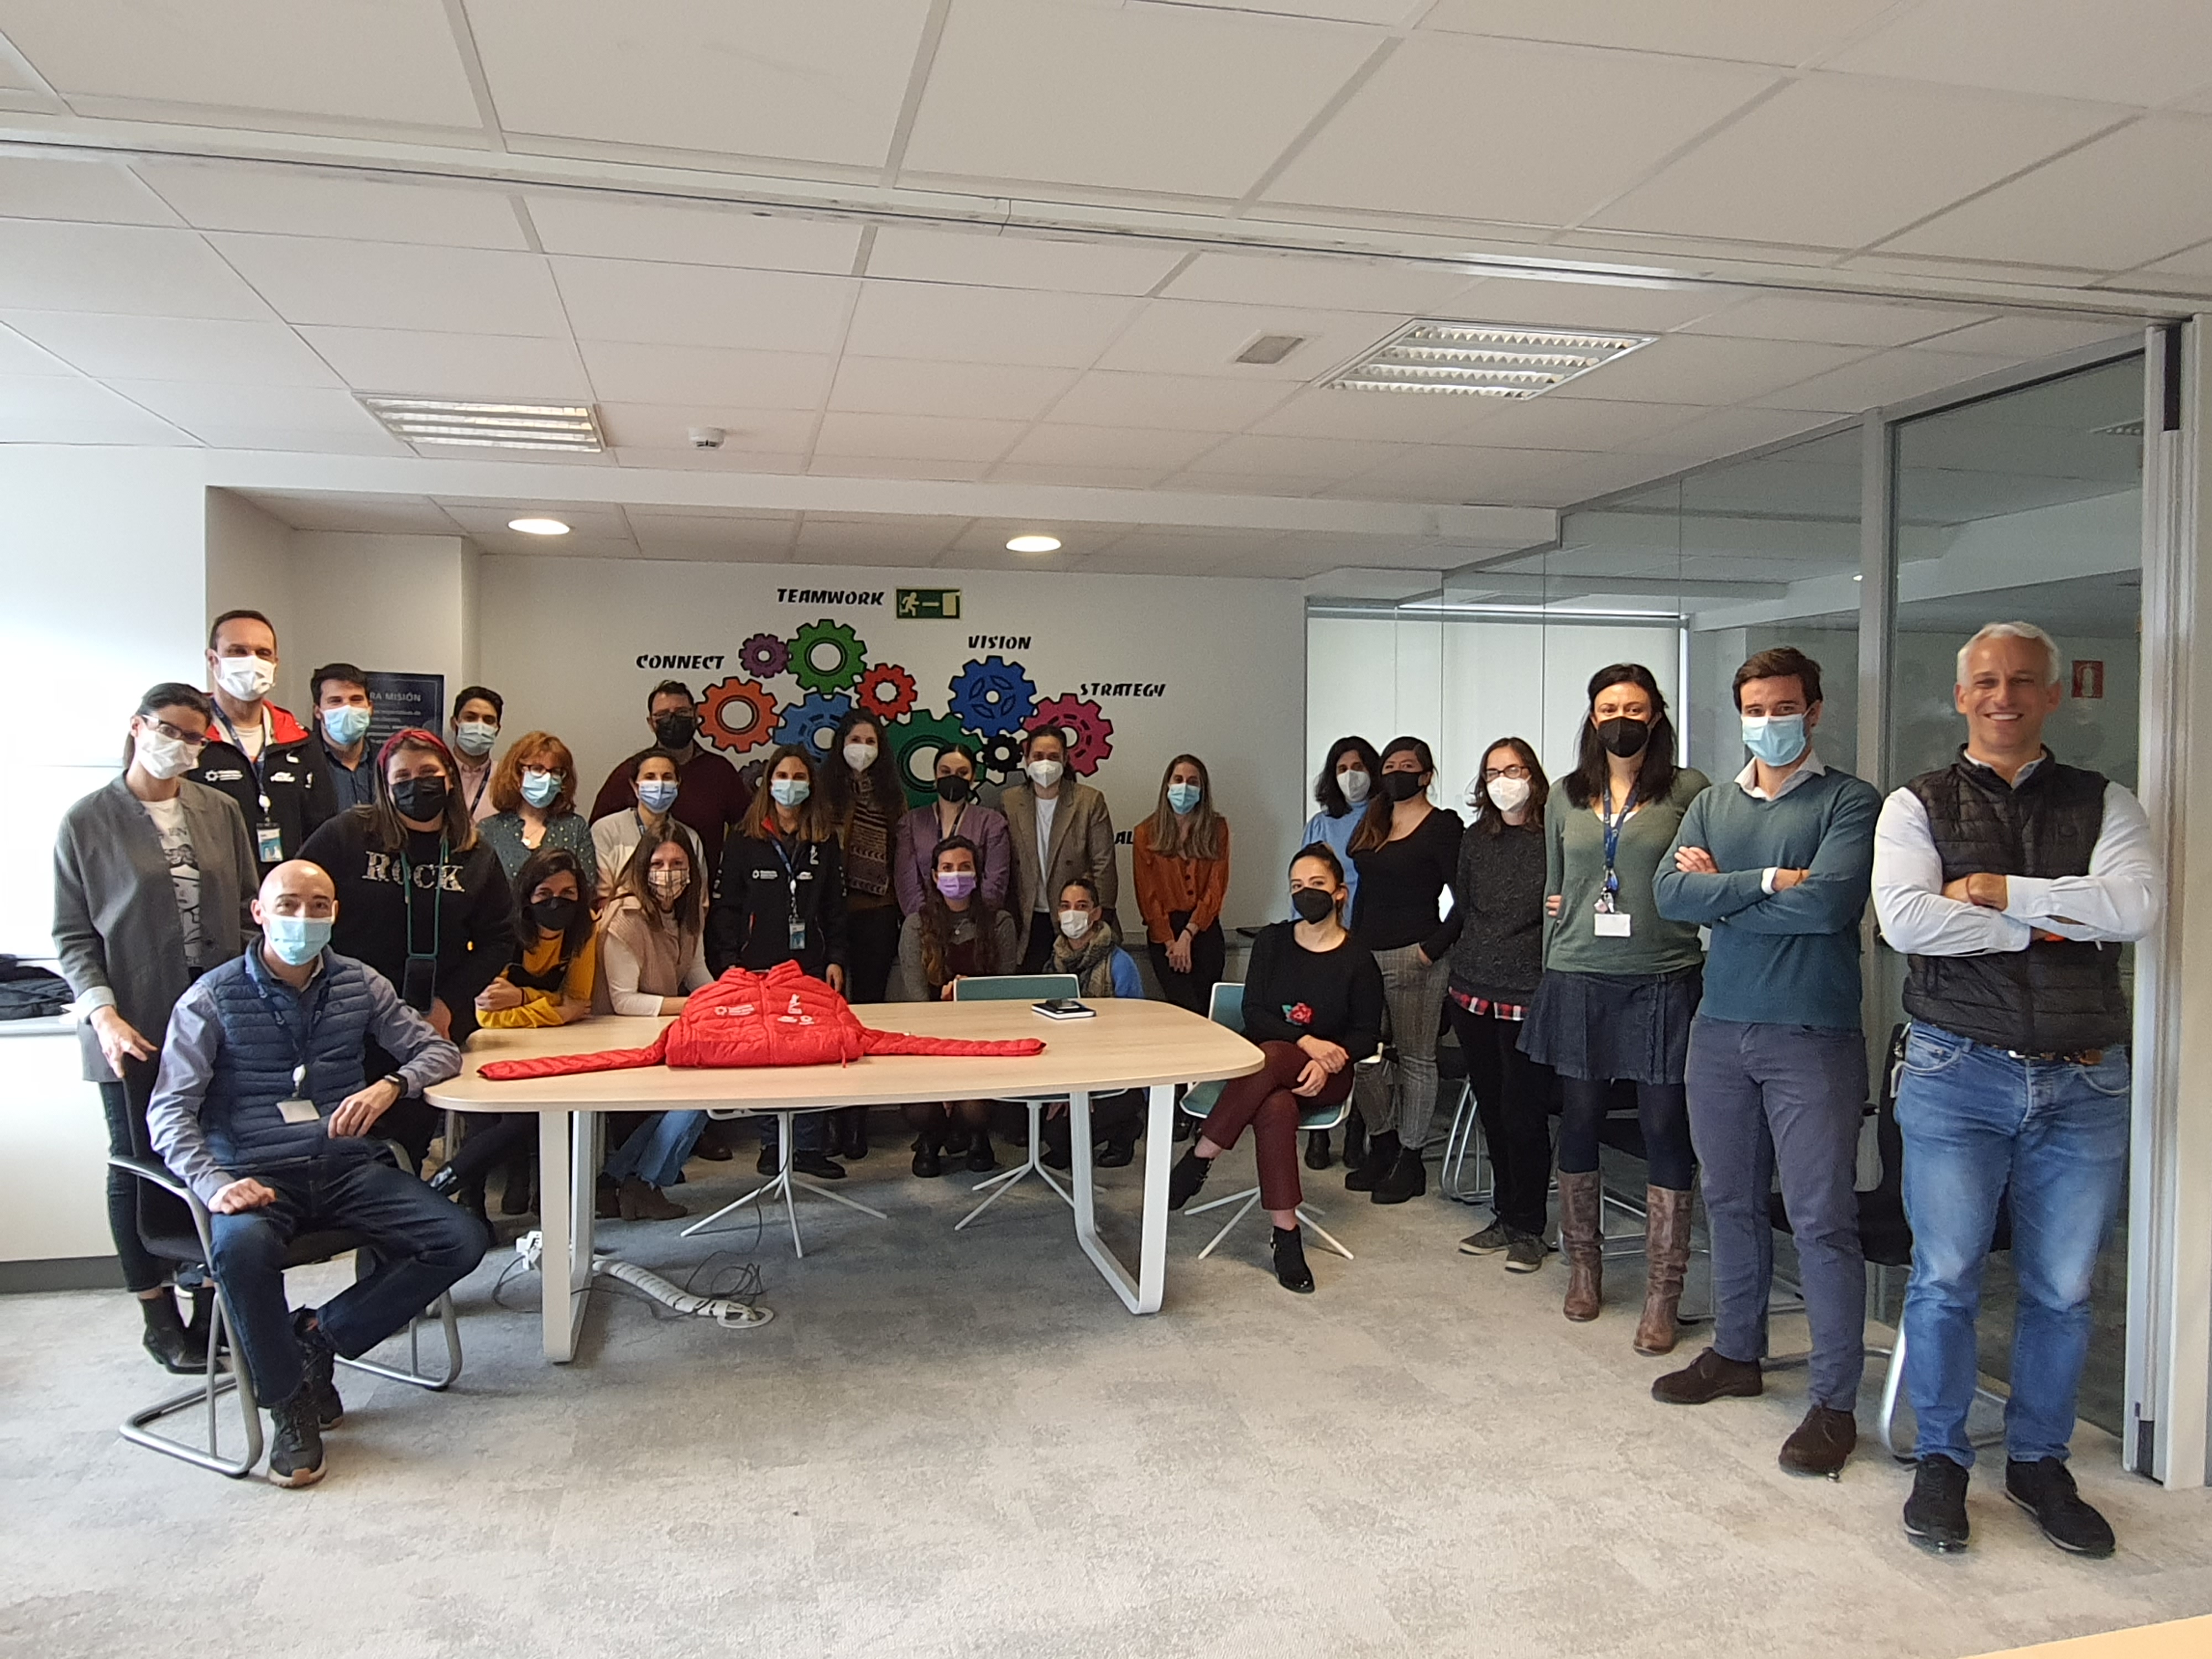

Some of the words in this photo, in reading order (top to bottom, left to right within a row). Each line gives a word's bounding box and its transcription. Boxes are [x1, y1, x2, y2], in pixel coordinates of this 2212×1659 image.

[777, 588, 885, 606] TEAMWORK
[968, 635, 1032, 650] VISION
[636, 654, 725, 670] CONNECT
[385, 692, 421, 702] MISIÓN
[1081, 682, 1166, 697] STRATEGY
[362, 851, 466, 893] ROCK
